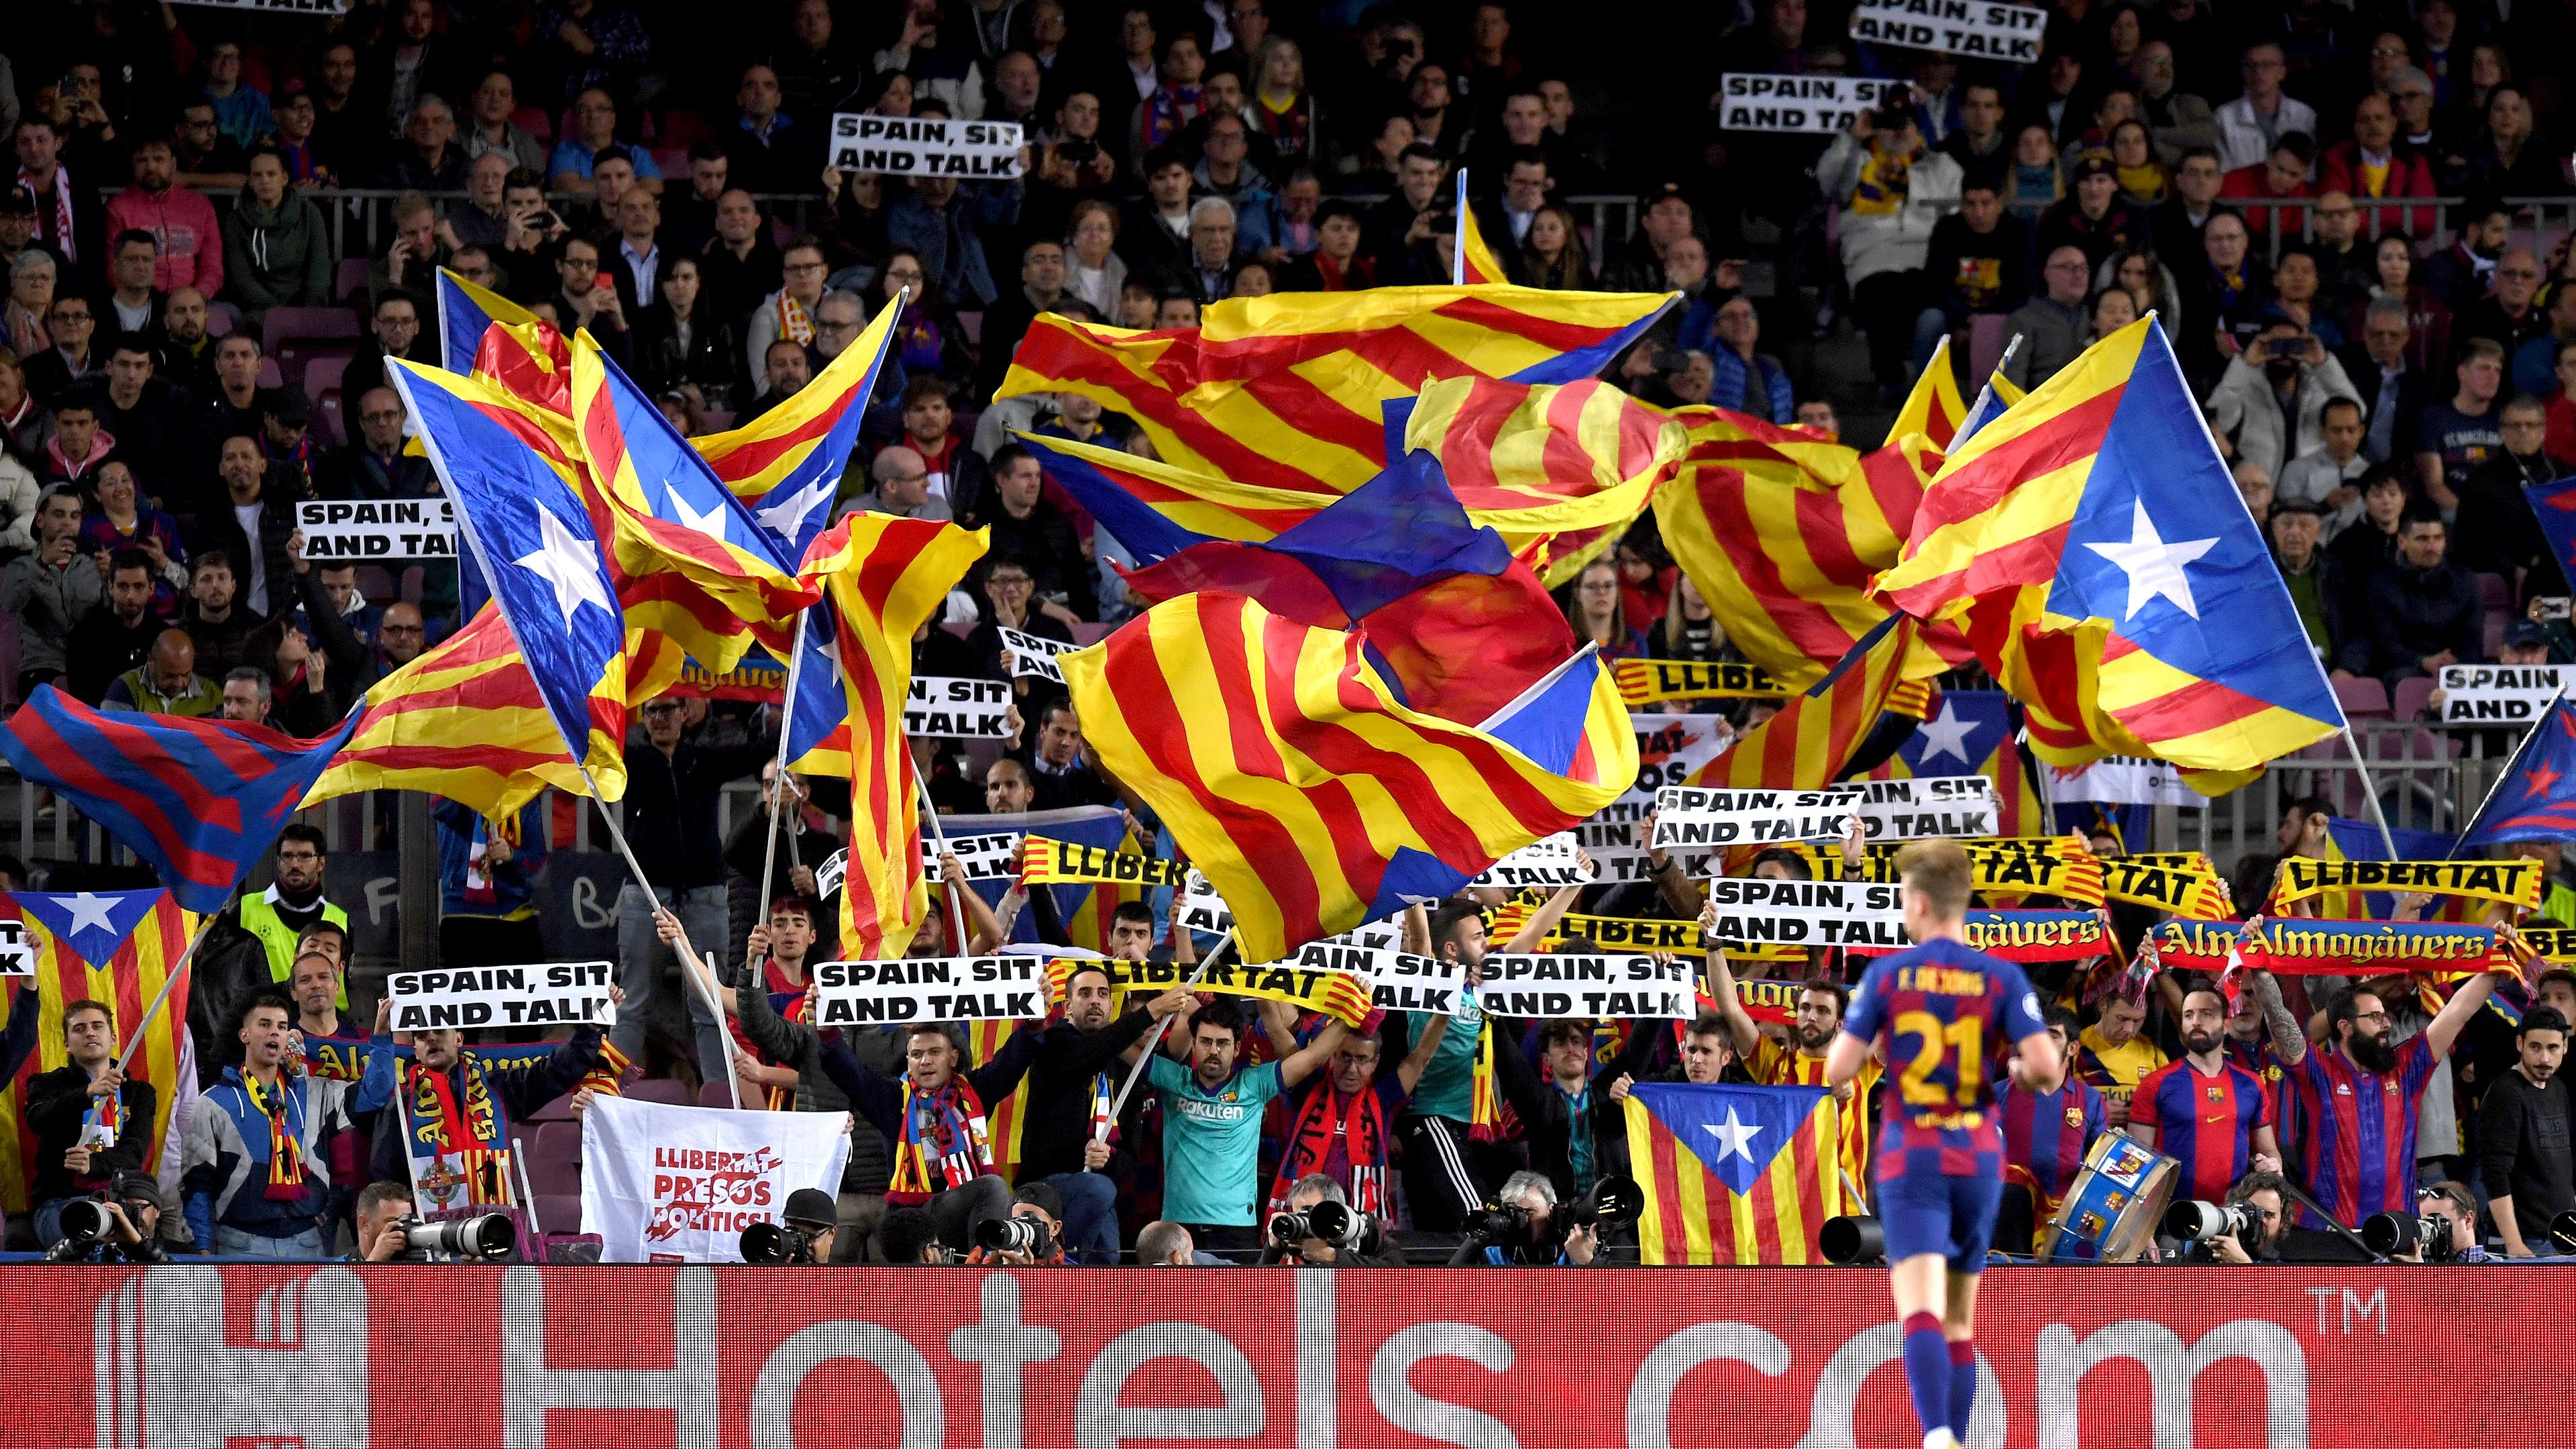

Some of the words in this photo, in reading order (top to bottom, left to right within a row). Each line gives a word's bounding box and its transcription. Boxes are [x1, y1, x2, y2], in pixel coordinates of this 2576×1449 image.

[1985, 7, 2039, 30] SIT
[1858, 18, 1934, 45] AND
[1945, 31, 2035, 60] TALK
[1727, 77, 1844, 103] SPAIN,
[837, 117, 955, 147] SPAIN,
[965, 125, 1018, 146] SIT
[1728, 108, 1806, 129] AND
[1817, 111, 1856, 130] TA
[835, 148, 916, 170] AND
[924, 153, 1016, 175] TALK
[303, 503, 430, 527] SPAIN,
[306, 535, 391, 556] AND
[400, 534, 457, 555] TA
[1018, 654, 1061, 680] AN
[948, 681, 1007, 703] SIT
[2449, 700, 2531, 719] AND
[904, 711, 1006, 735] TALK
[1658, 789, 1784, 812] SPAIN,
[1795, 791, 1860, 807] SIT
[1829, 782, 1921, 806] AIN,
[1930, 779, 1987, 802] SIT
[1655, 820, 1739, 845] AND
[1750, 815, 1849, 839] TALK
[1892, 812, 1989, 837] TALK
[952, 835, 1013, 855] SIT
[1058, 843, 1191, 886] LLIBER
[1496, 867, 1586, 885] TALK
[2289, 861, 2528, 896] LLIBERTAT
[1715, 881, 1855, 912] SPAIN,
[1865, 887, 1904, 910] SI
[1716, 916, 1809, 941] AND
[1964, 914, 2102, 953] gàvers
[2248, 923, 2485, 965] Almogàvers
[394, 969, 536, 995] SPAIN,
[547, 965, 608, 987] SIT
[820, 961, 961, 987] SPAIN,
[972, 959, 1036, 981] SIT
[1395, 955, 1455, 979] SIT
[1481, 958, 1617, 984] SPAIN,
[1627, 958, 1686, 982] SIT
[824, 997, 918, 1023] AND
[928, 992, 1036, 1018] TALK
[1371, 985, 1453, 1012] ALK
[1483, 992, 1572, 1016] AND
[1582, 992, 1687, 1016] TALK
[398, 1002, 492, 1028] AND
[502, 998, 609, 1023] TALK
[1894, 1010, 1984, 1106] 21
[1176, 1096, 1244, 1120] Rakuten
[655, 1147, 771, 1173] LLIBERTAT
[653, 1174, 771, 1206] PRESOS
[501, 1267, 2308, 1449] Hotelscom
